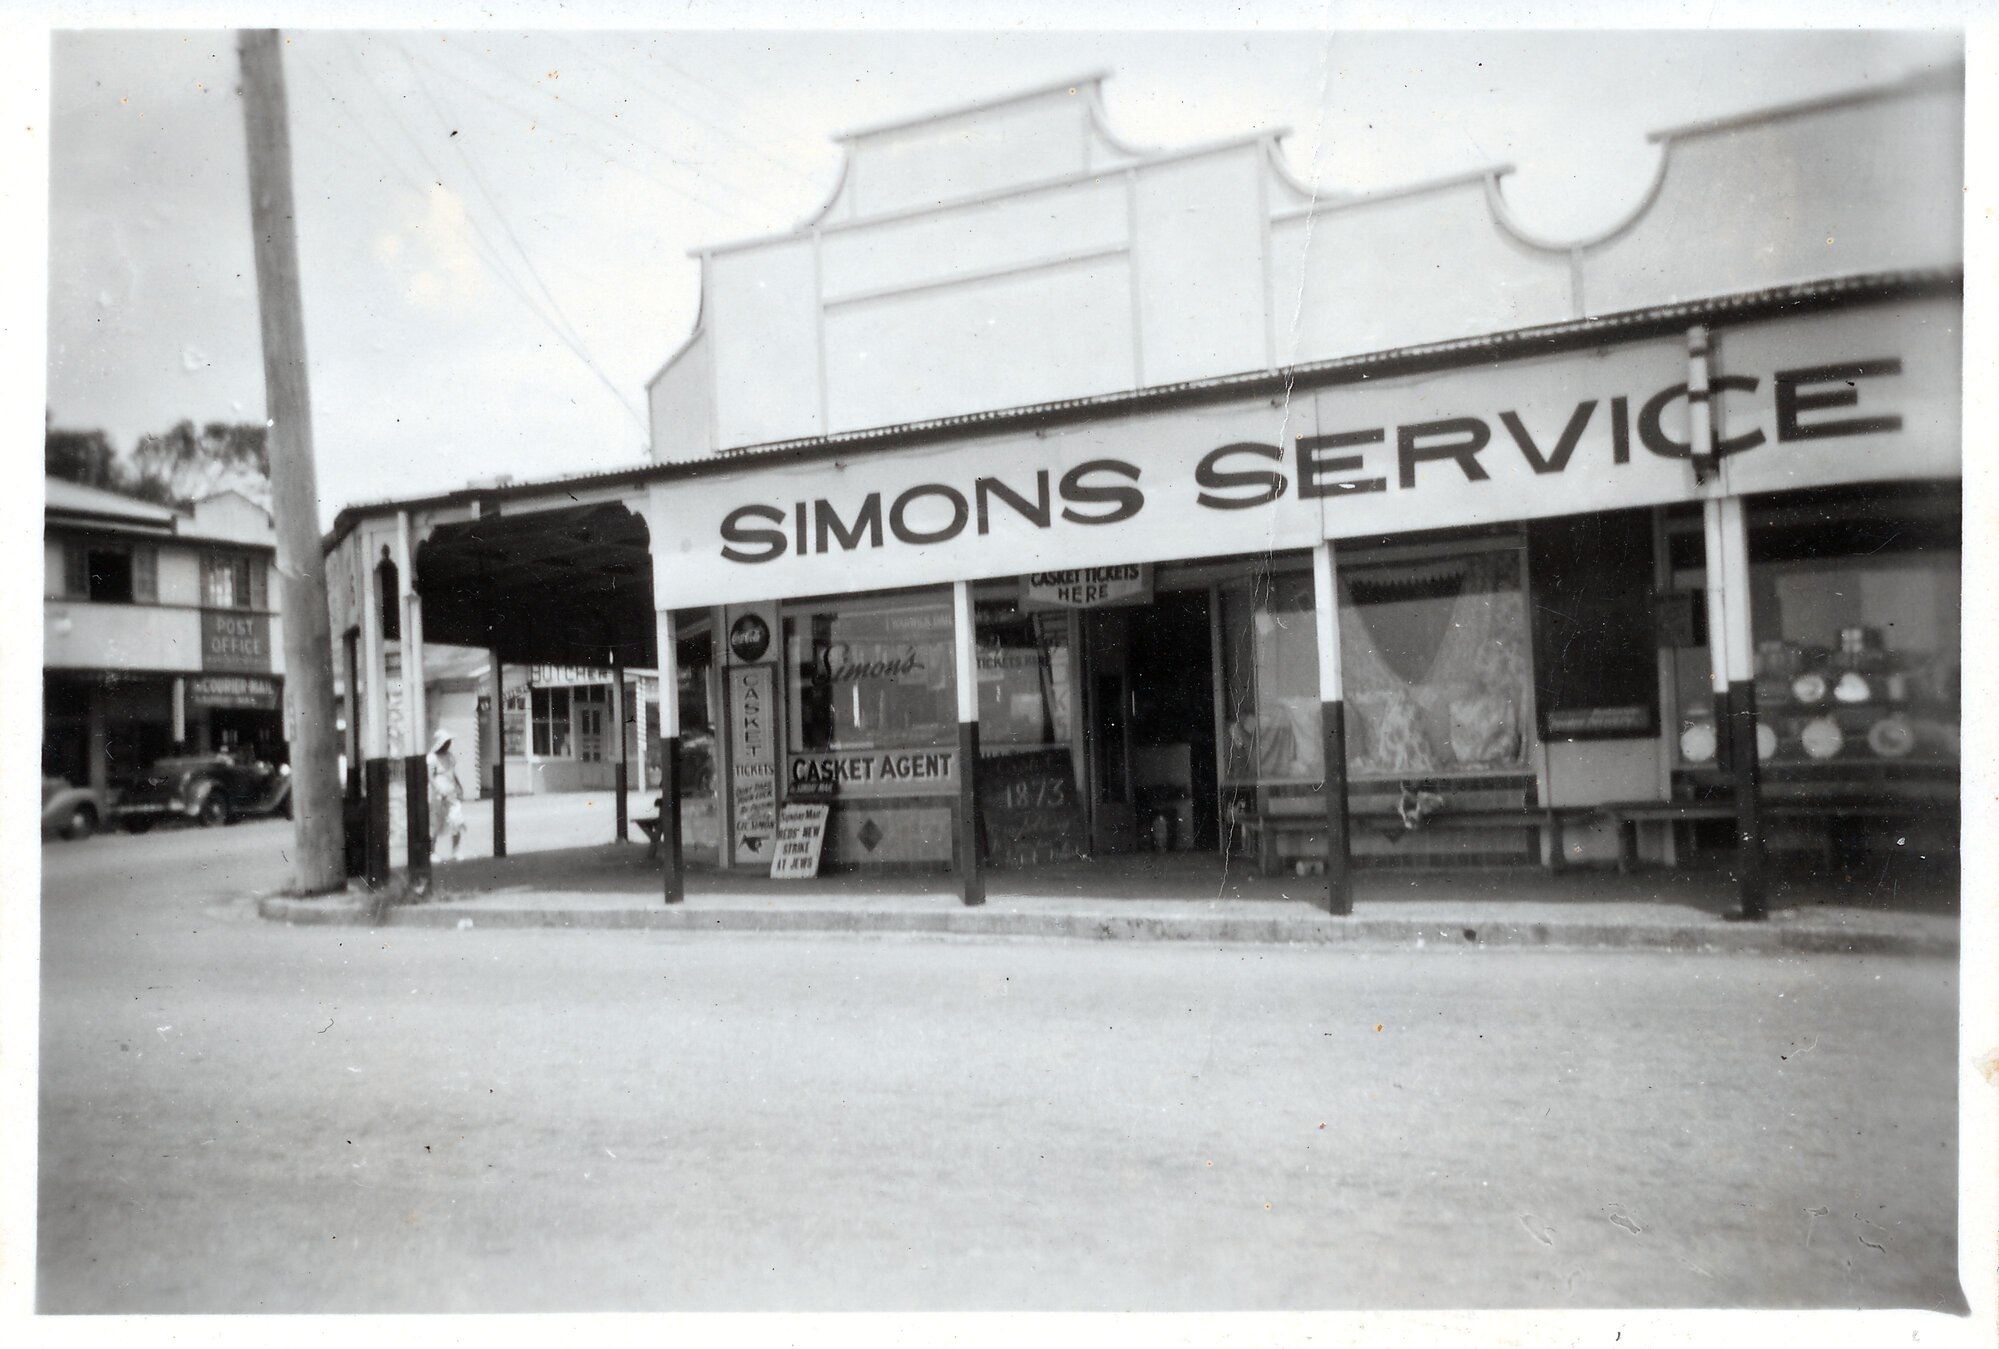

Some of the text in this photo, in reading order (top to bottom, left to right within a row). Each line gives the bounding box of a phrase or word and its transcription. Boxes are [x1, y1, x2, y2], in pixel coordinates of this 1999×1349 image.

[720, 358, 1903, 563] SIMONS SERVICE
[1031, 570, 1079, 586] CASKET
[1058, 584, 1108, 603] HERE
[215, 616, 253, 635] POST
[211, 637, 261, 655] OFFICE
[743, 676, 760, 757] CASKET
[735, 764, 774, 777] TICKETS
[792, 753, 952, 782] CASKET AGENT
[1006, 777, 1065, 808] 1873
[802, 826, 820, 838] NEW
[782, 841, 810, 855] STRIKE
[790, 857, 813, 870] JEWS
